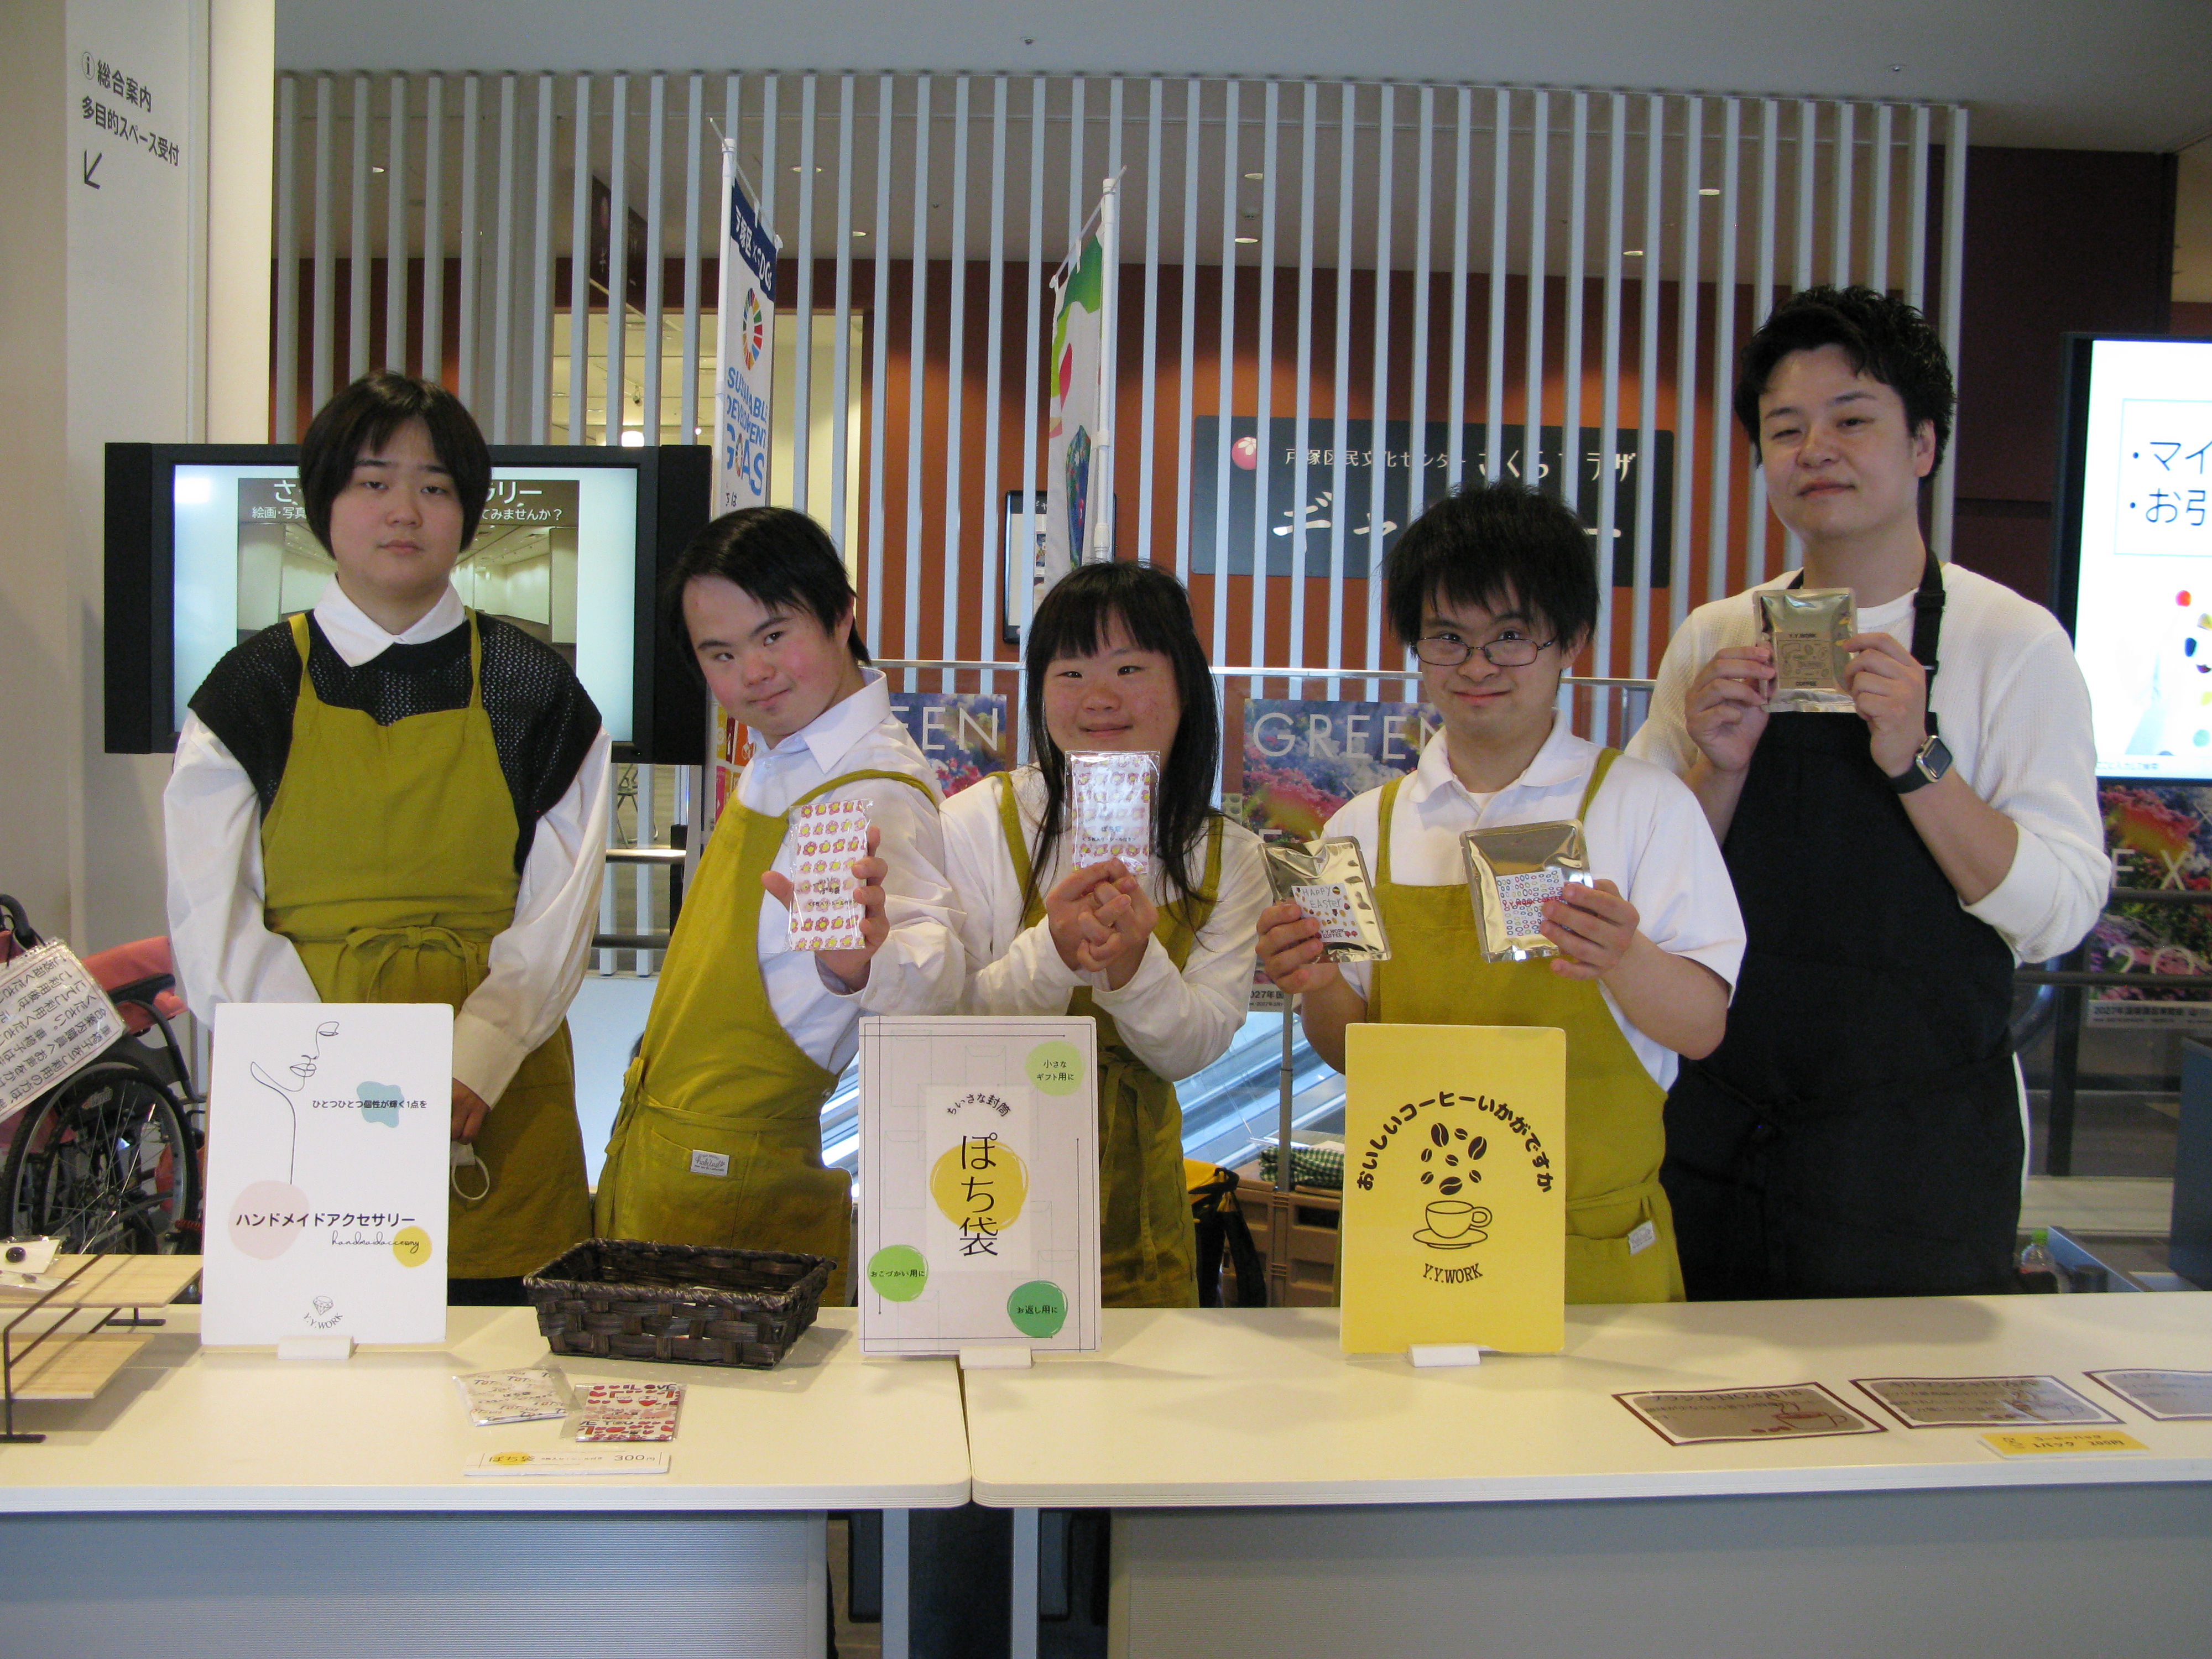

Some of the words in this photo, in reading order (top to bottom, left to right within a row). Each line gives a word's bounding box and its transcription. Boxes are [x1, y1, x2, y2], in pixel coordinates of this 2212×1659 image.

[97, 59, 152, 113] 総合案内
[82, 96, 180, 166] 多目的スペース受付
[1286, 448, 1466, 468] 戸塚区民文化センタ
[274, 479, 303, 503] さ
[1044, 1059, 1067, 1068] 小さな
[1036, 1072, 1074, 1082] ギフト用に
[312, 1099, 428, 1109] ひとつひとつ個性が輝く1点を
[946, 1093, 1011, 1117] ちいさな封筒
[1357, 1091, 1554, 1193] おいしいコーヒーいかがですか
[958, 1131, 999, 1257] ぽち袋
[236, 1213, 415, 1228] ハンドメイドアクセサリー
[870, 1269, 926, 1279] おこづかい用に
[1423, 1263, 1483, 1284] Y.Y.WORK
[1016, 1305, 1058, 1316] お返し用に
